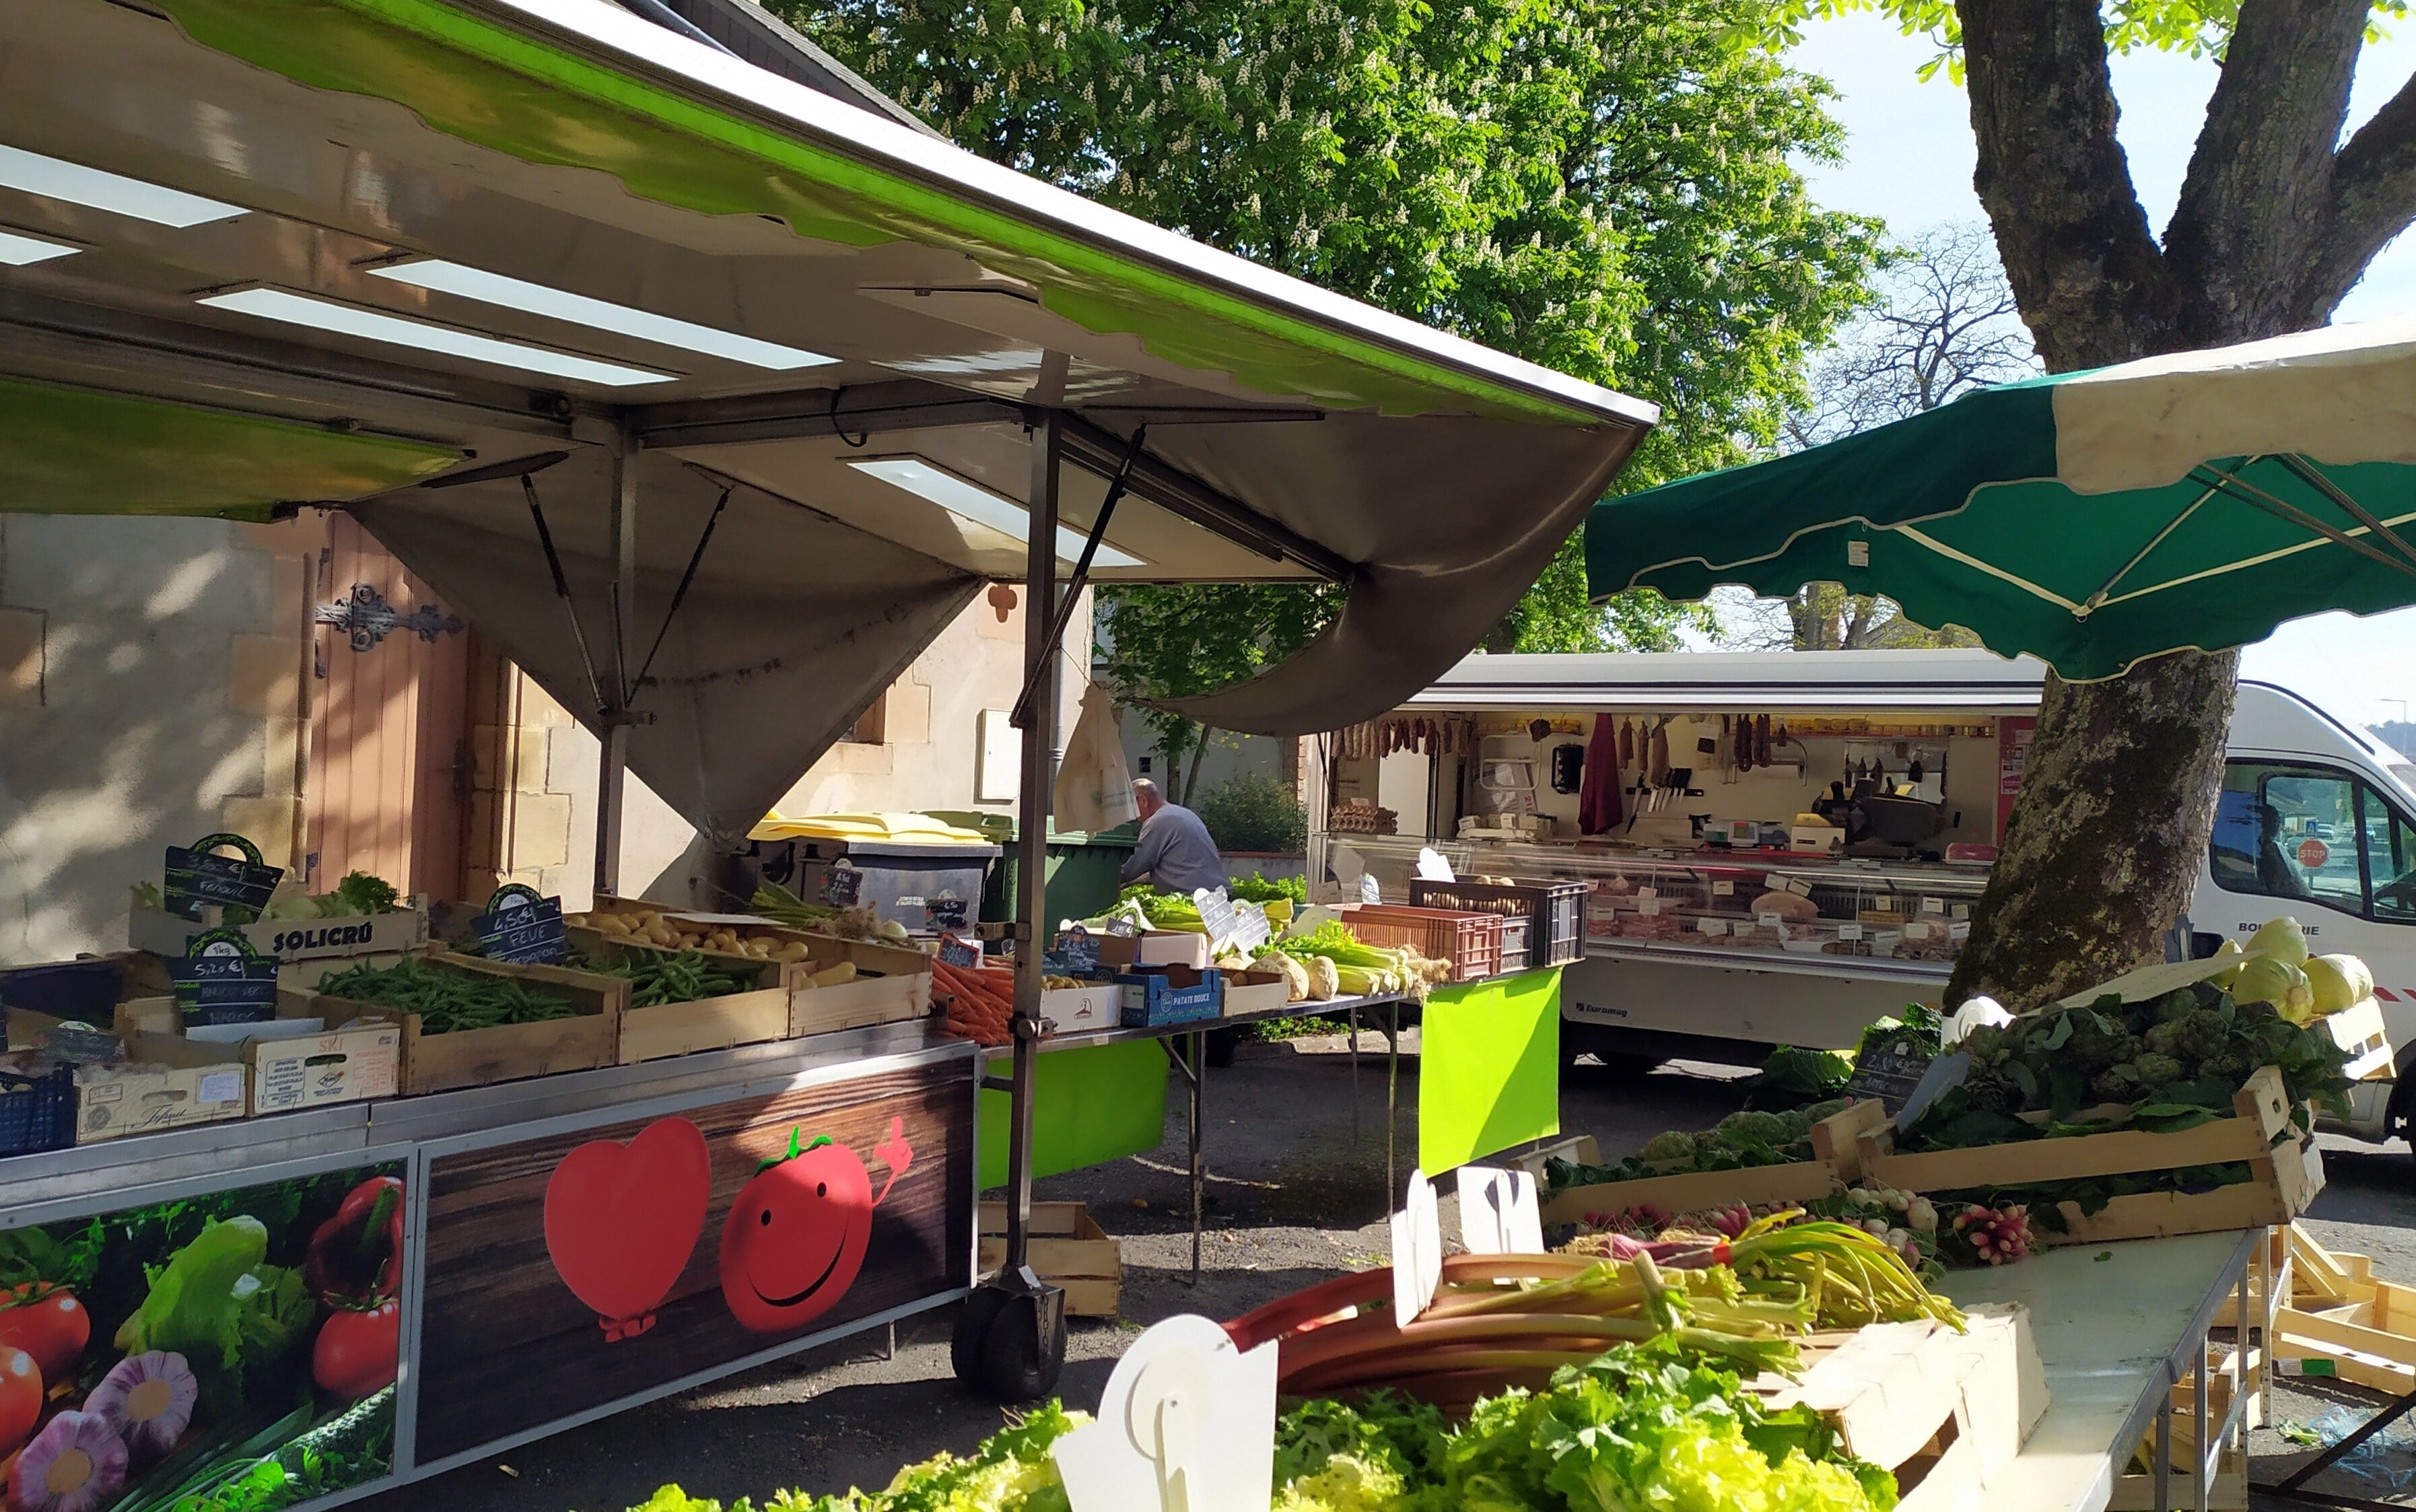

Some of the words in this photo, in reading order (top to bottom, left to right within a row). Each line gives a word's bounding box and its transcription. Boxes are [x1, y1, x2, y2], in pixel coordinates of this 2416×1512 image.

[2300, 850, 2326, 859] STOP
[1173, 994, 1193, 1006] PATATE
[1194, 993, 1210, 1002] DOUCE
[1585, 1004, 1628, 1018] Euromag
